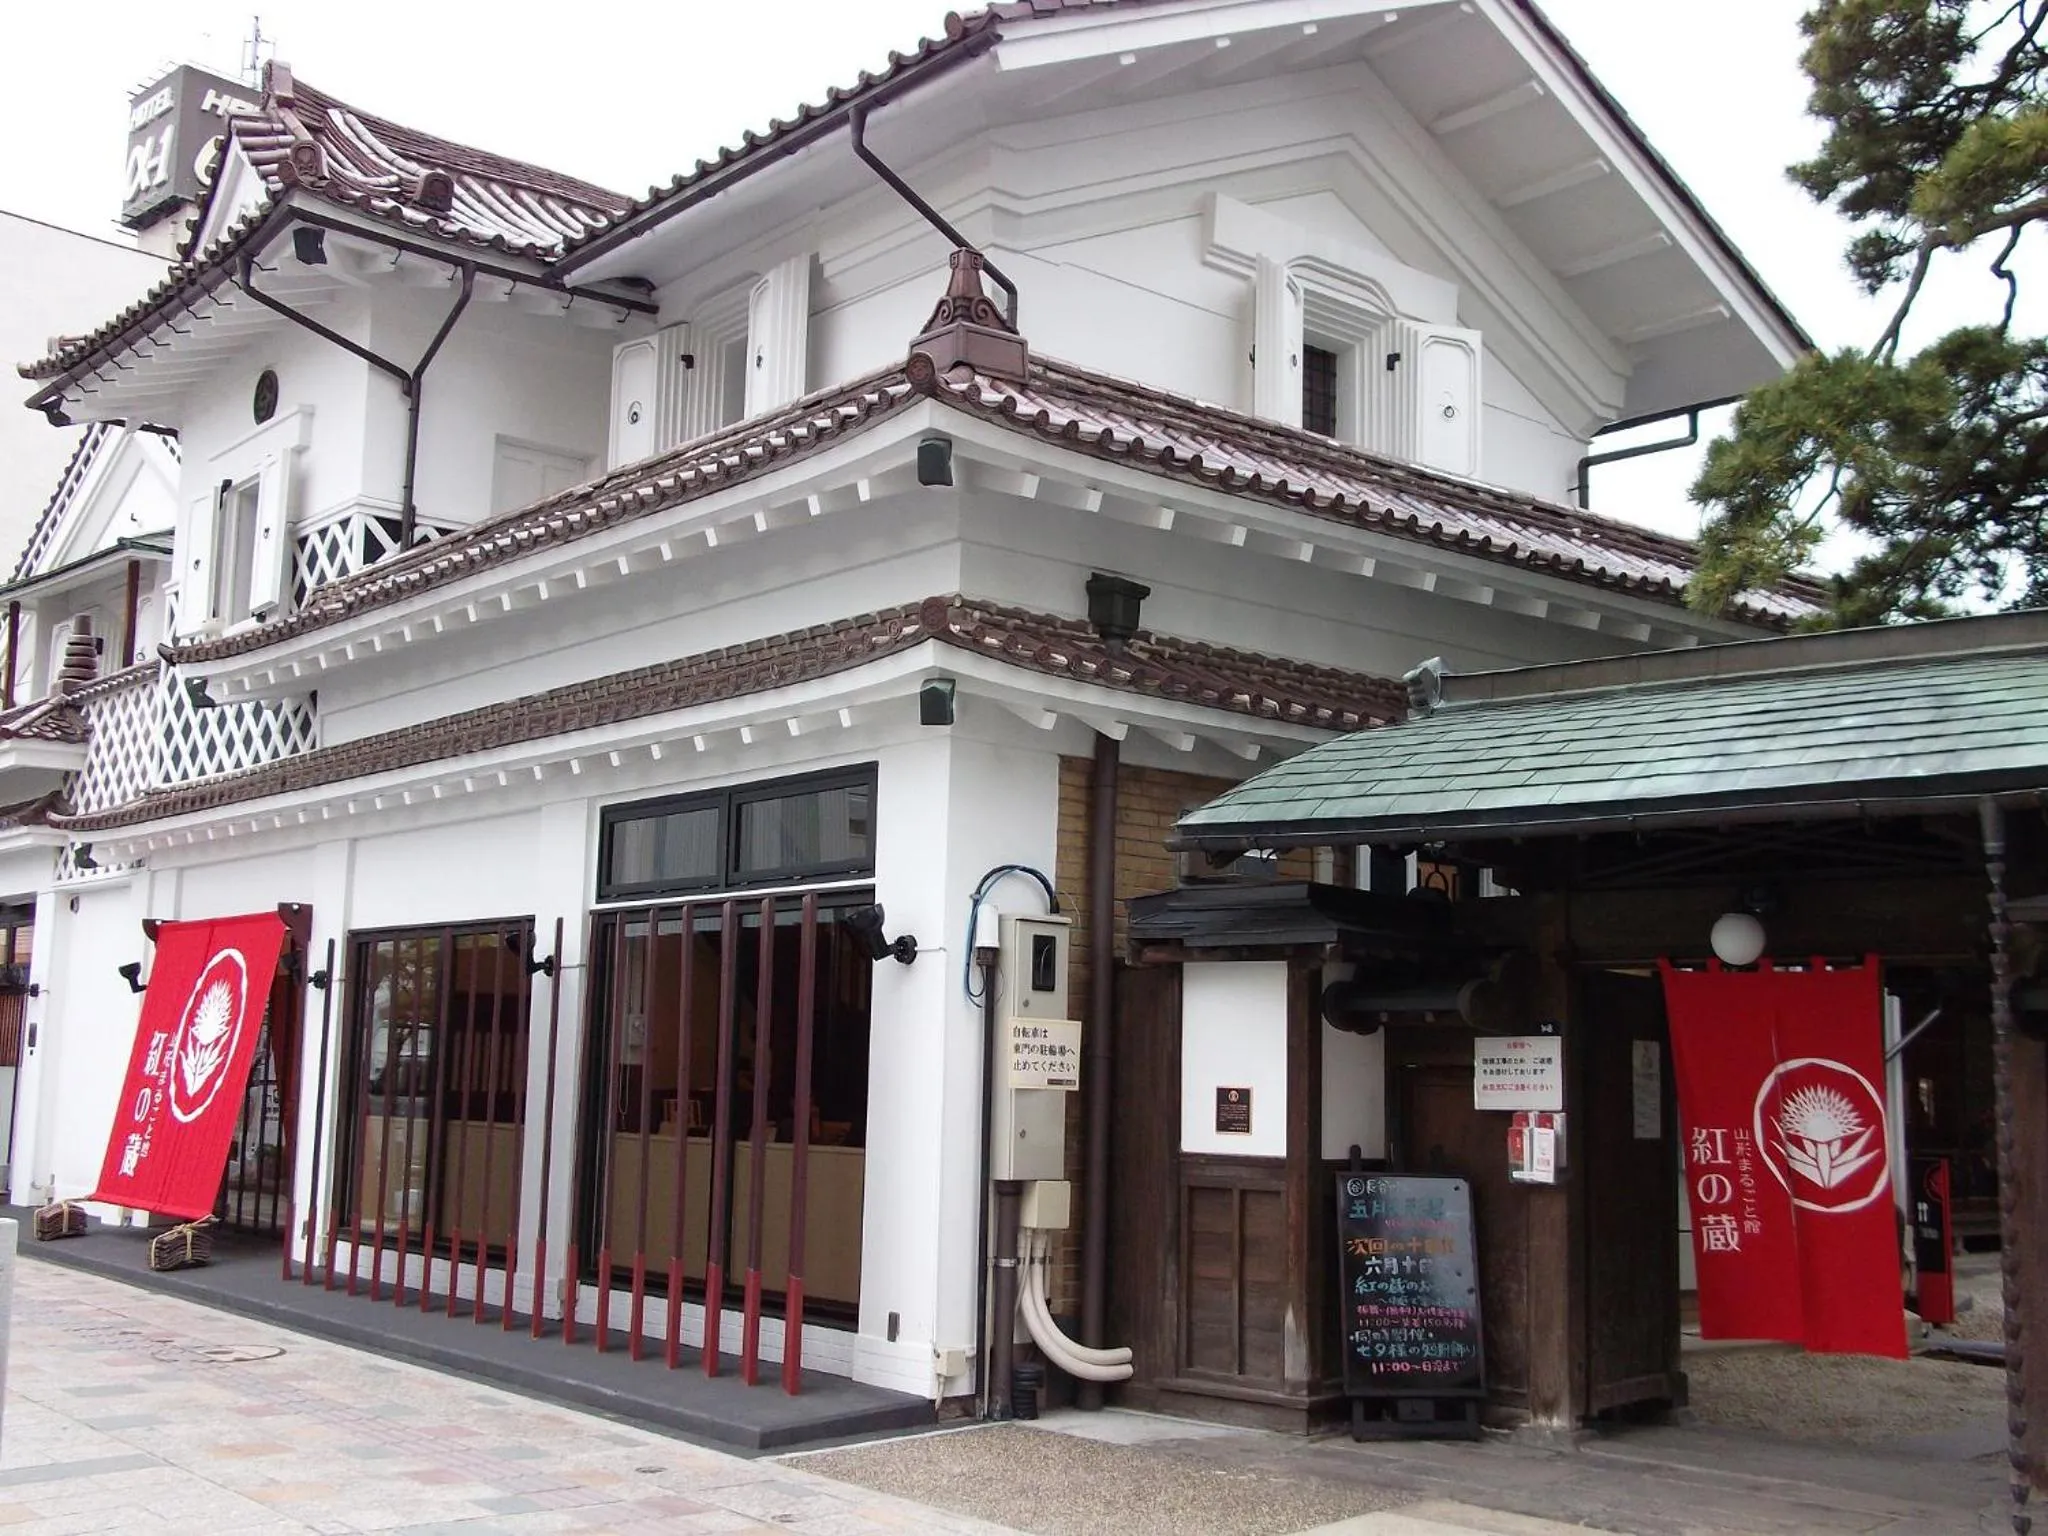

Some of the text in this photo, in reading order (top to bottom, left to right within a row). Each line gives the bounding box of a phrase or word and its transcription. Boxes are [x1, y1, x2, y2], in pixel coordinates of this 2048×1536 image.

[1013, 1026, 1048, 1038] 自転車は
[1013, 1060, 1076, 1073] 止めてください
[119, 1032, 168, 1177] 紅の蔵
[1691, 1127, 1742, 1253] 紅の蔵
[1733, 1127, 1762, 1234] 山形まるごと館
